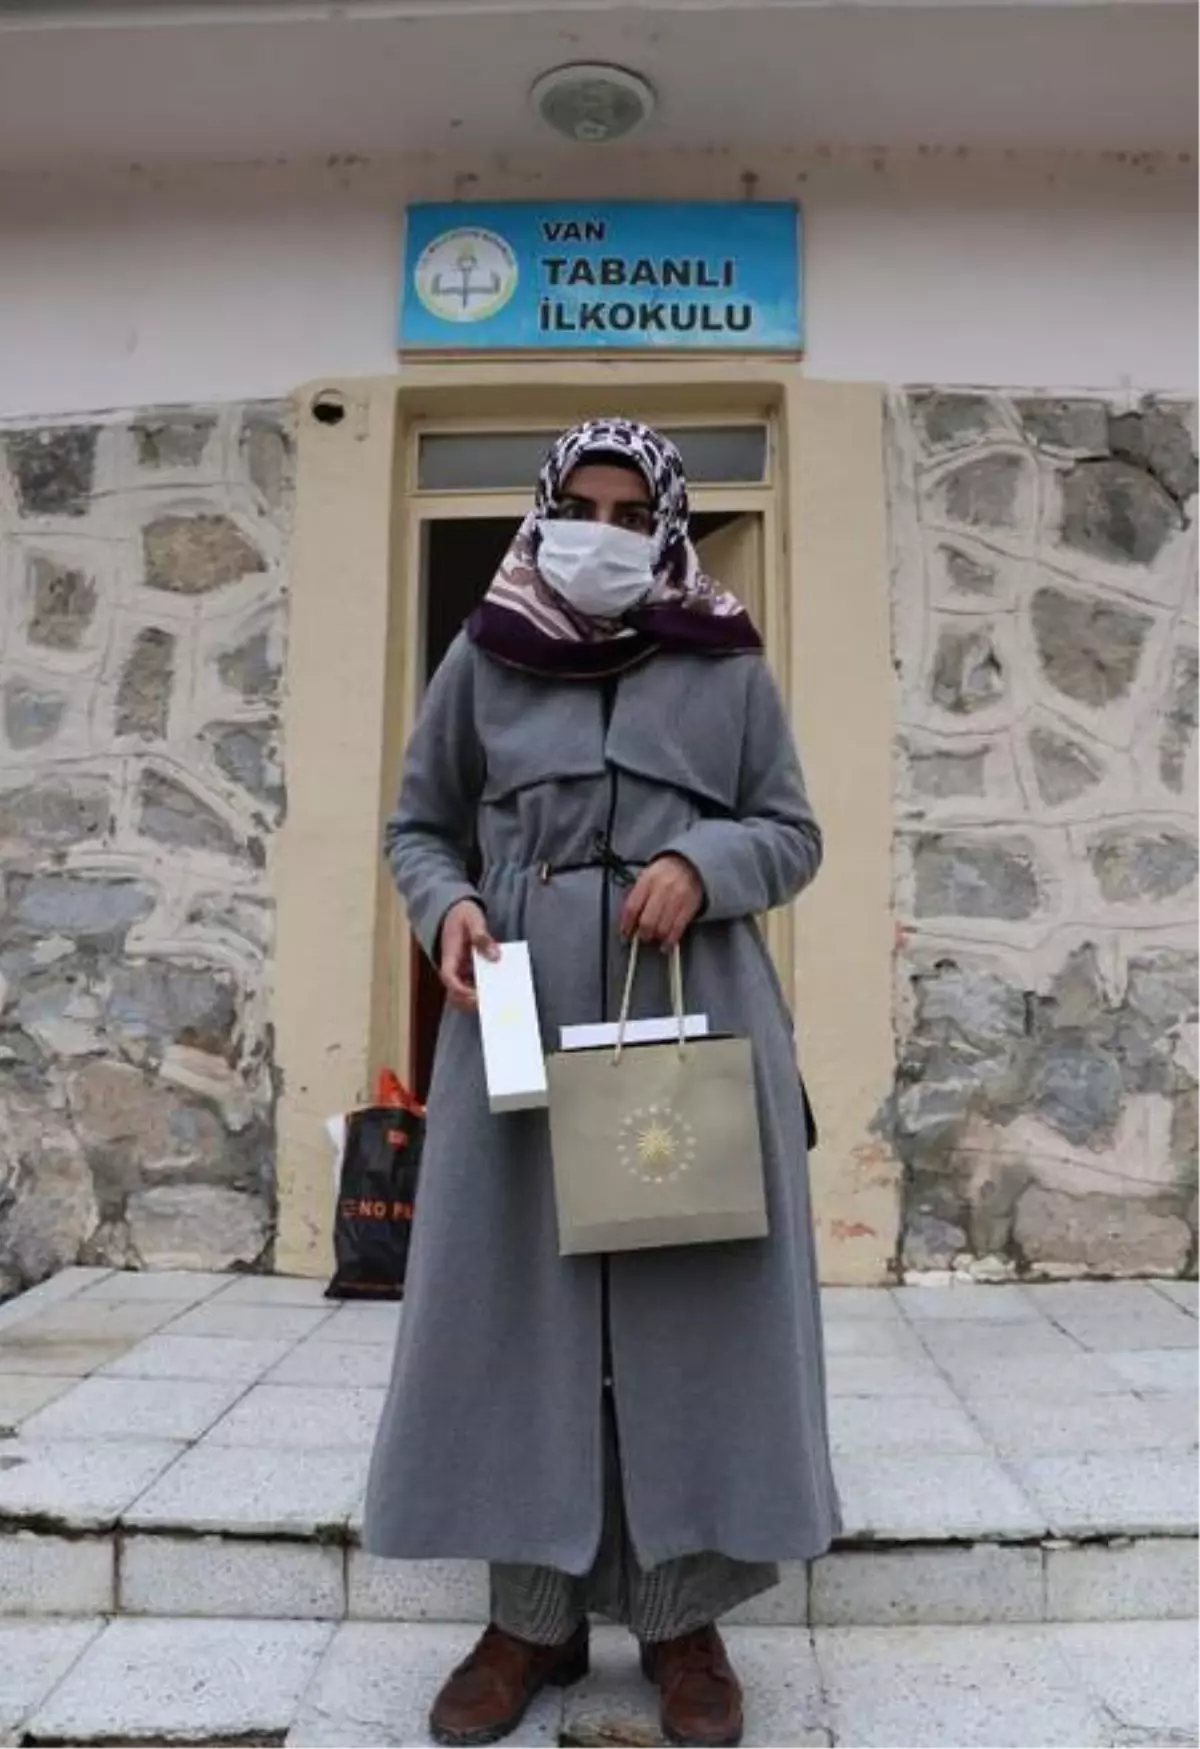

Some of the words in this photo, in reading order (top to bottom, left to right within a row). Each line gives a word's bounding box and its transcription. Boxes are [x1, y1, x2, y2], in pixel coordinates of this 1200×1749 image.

[542, 221, 606, 242] VAN
[541, 258, 734, 287] TABANLI
[540, 297, 753, 331] İLKOKULU
